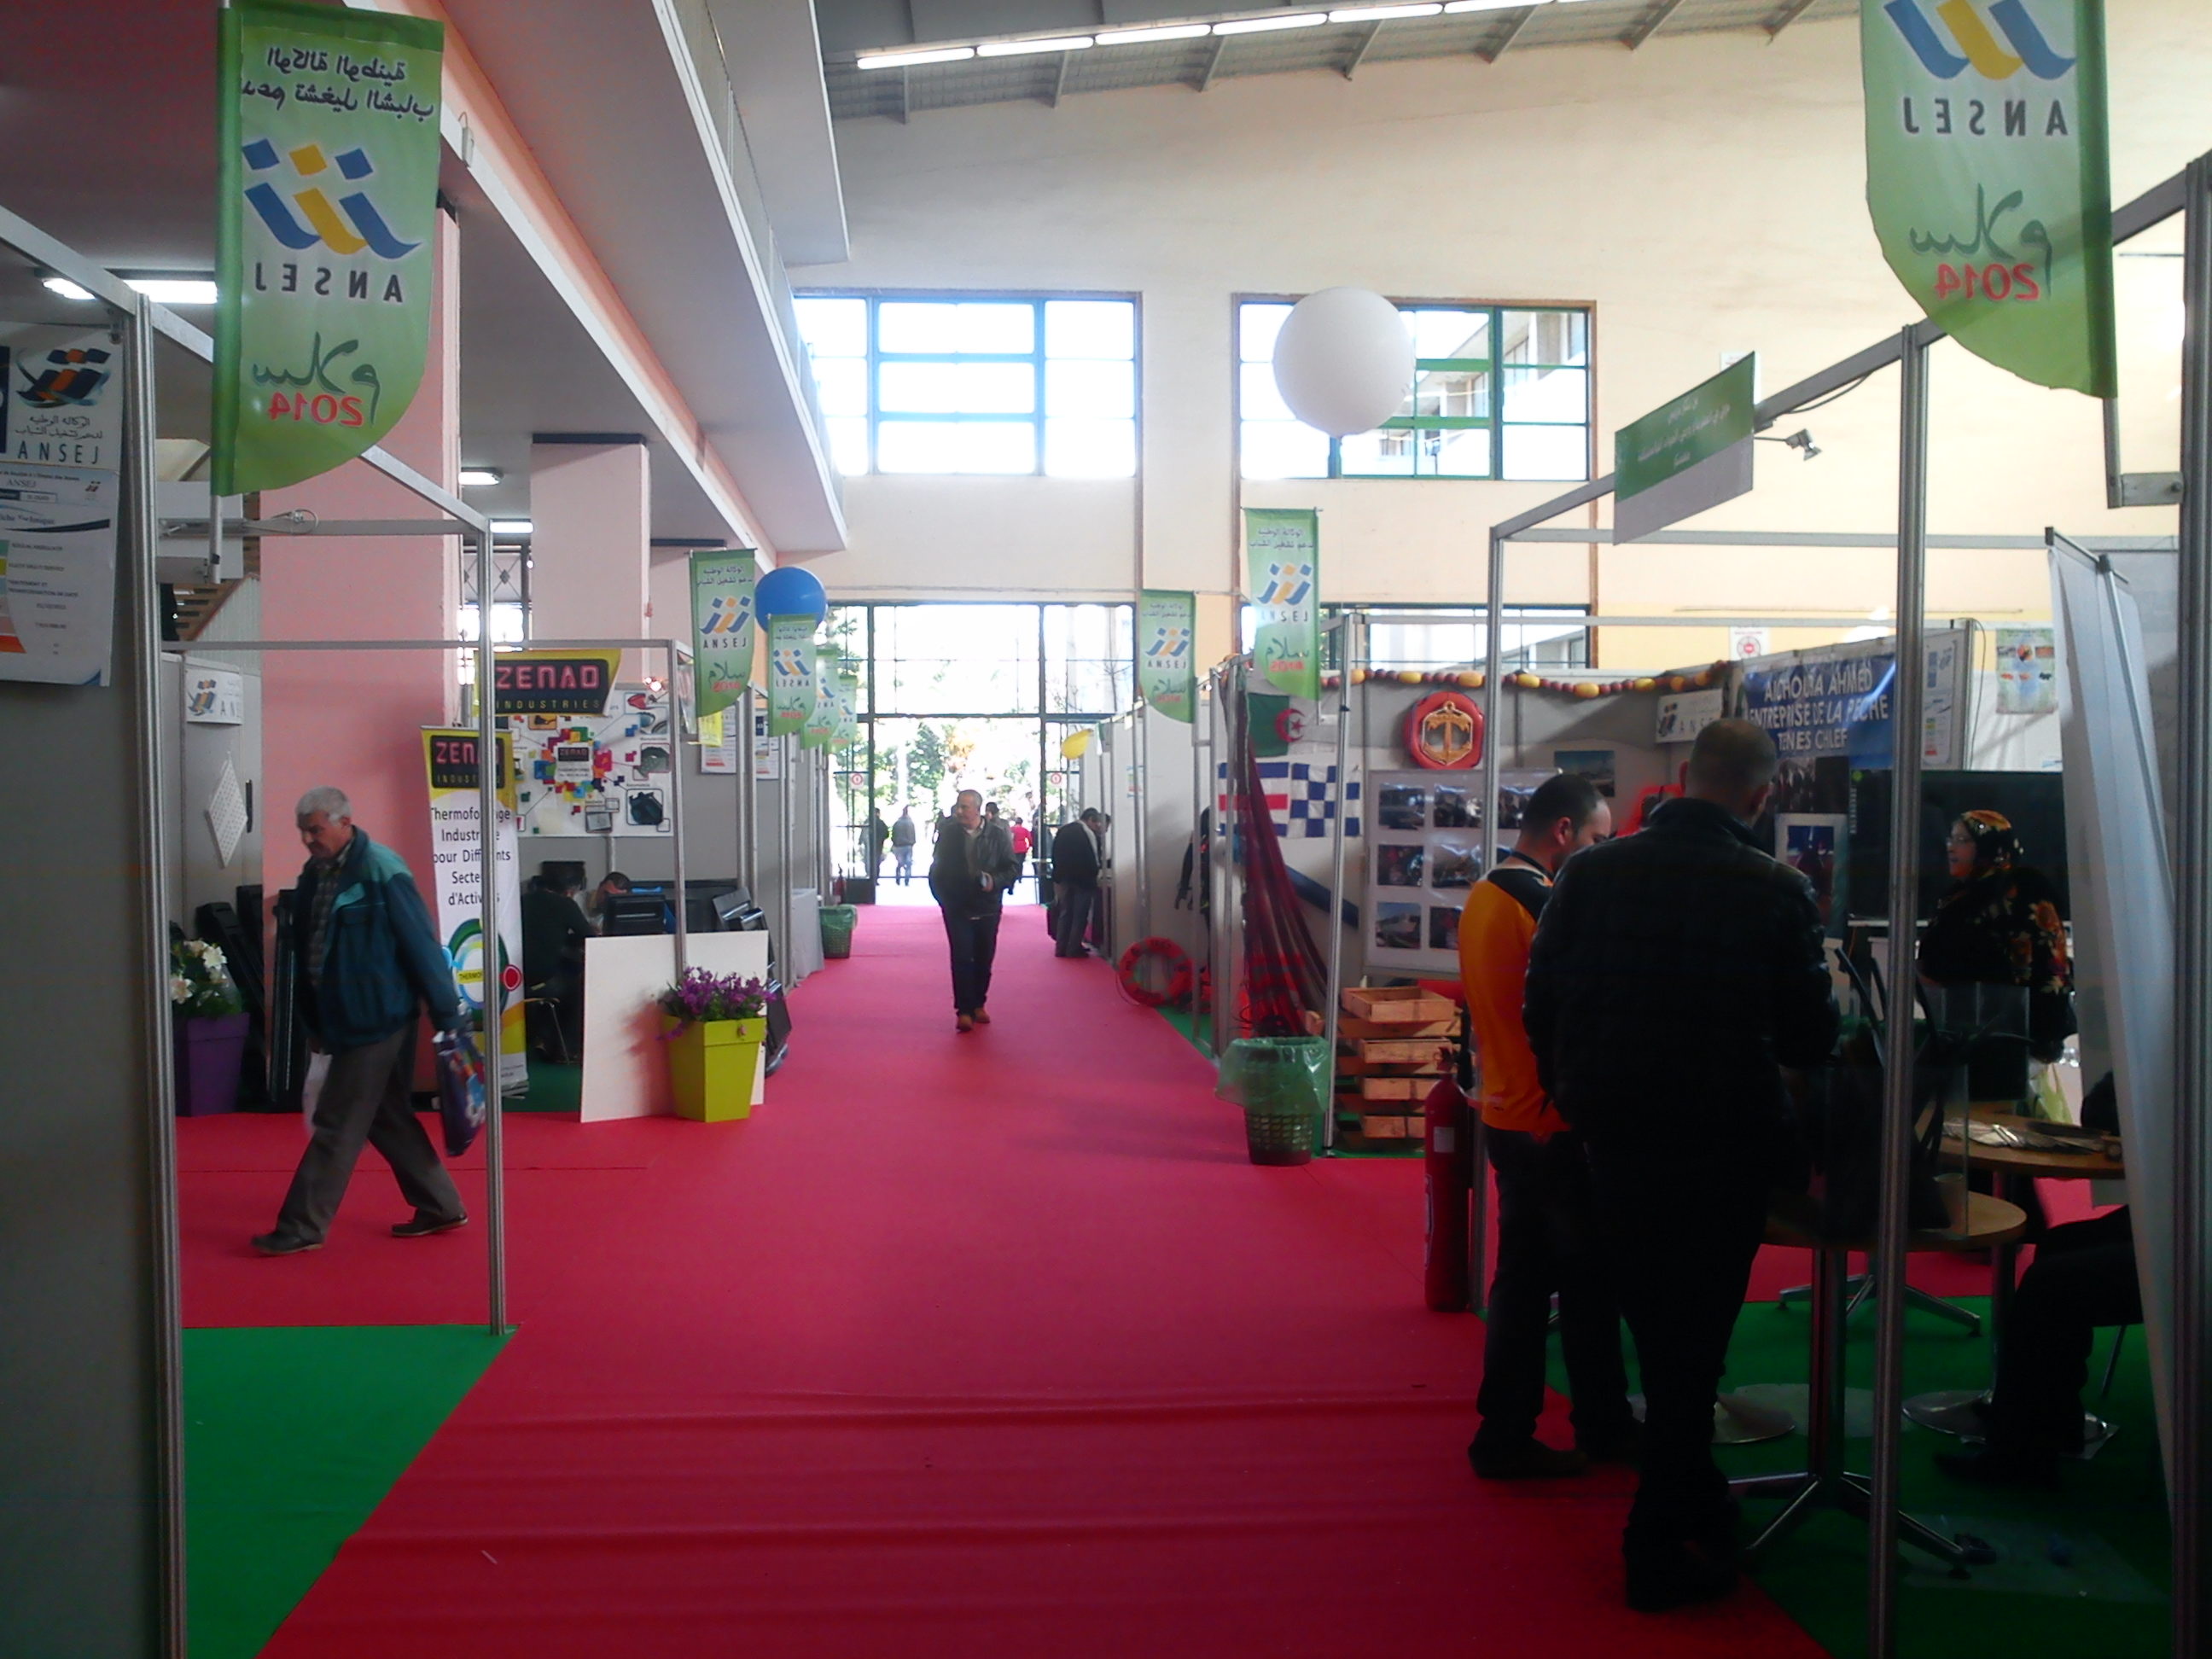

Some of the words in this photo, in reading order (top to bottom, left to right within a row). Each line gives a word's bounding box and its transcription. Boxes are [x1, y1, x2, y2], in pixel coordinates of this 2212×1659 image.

[17, 440, 99, 464] ANSEJ
[702, 637, 748, 649] ANSEJ
[1147, 659, 1187, 670] ANSEJ
[1827, 667, 1873, 696] AHMED
[1749, 702, 1811, 730] ENTREPRISE
[1813, 701, 1824, 725] DE
[1826, 700, 1842, 724] LA
